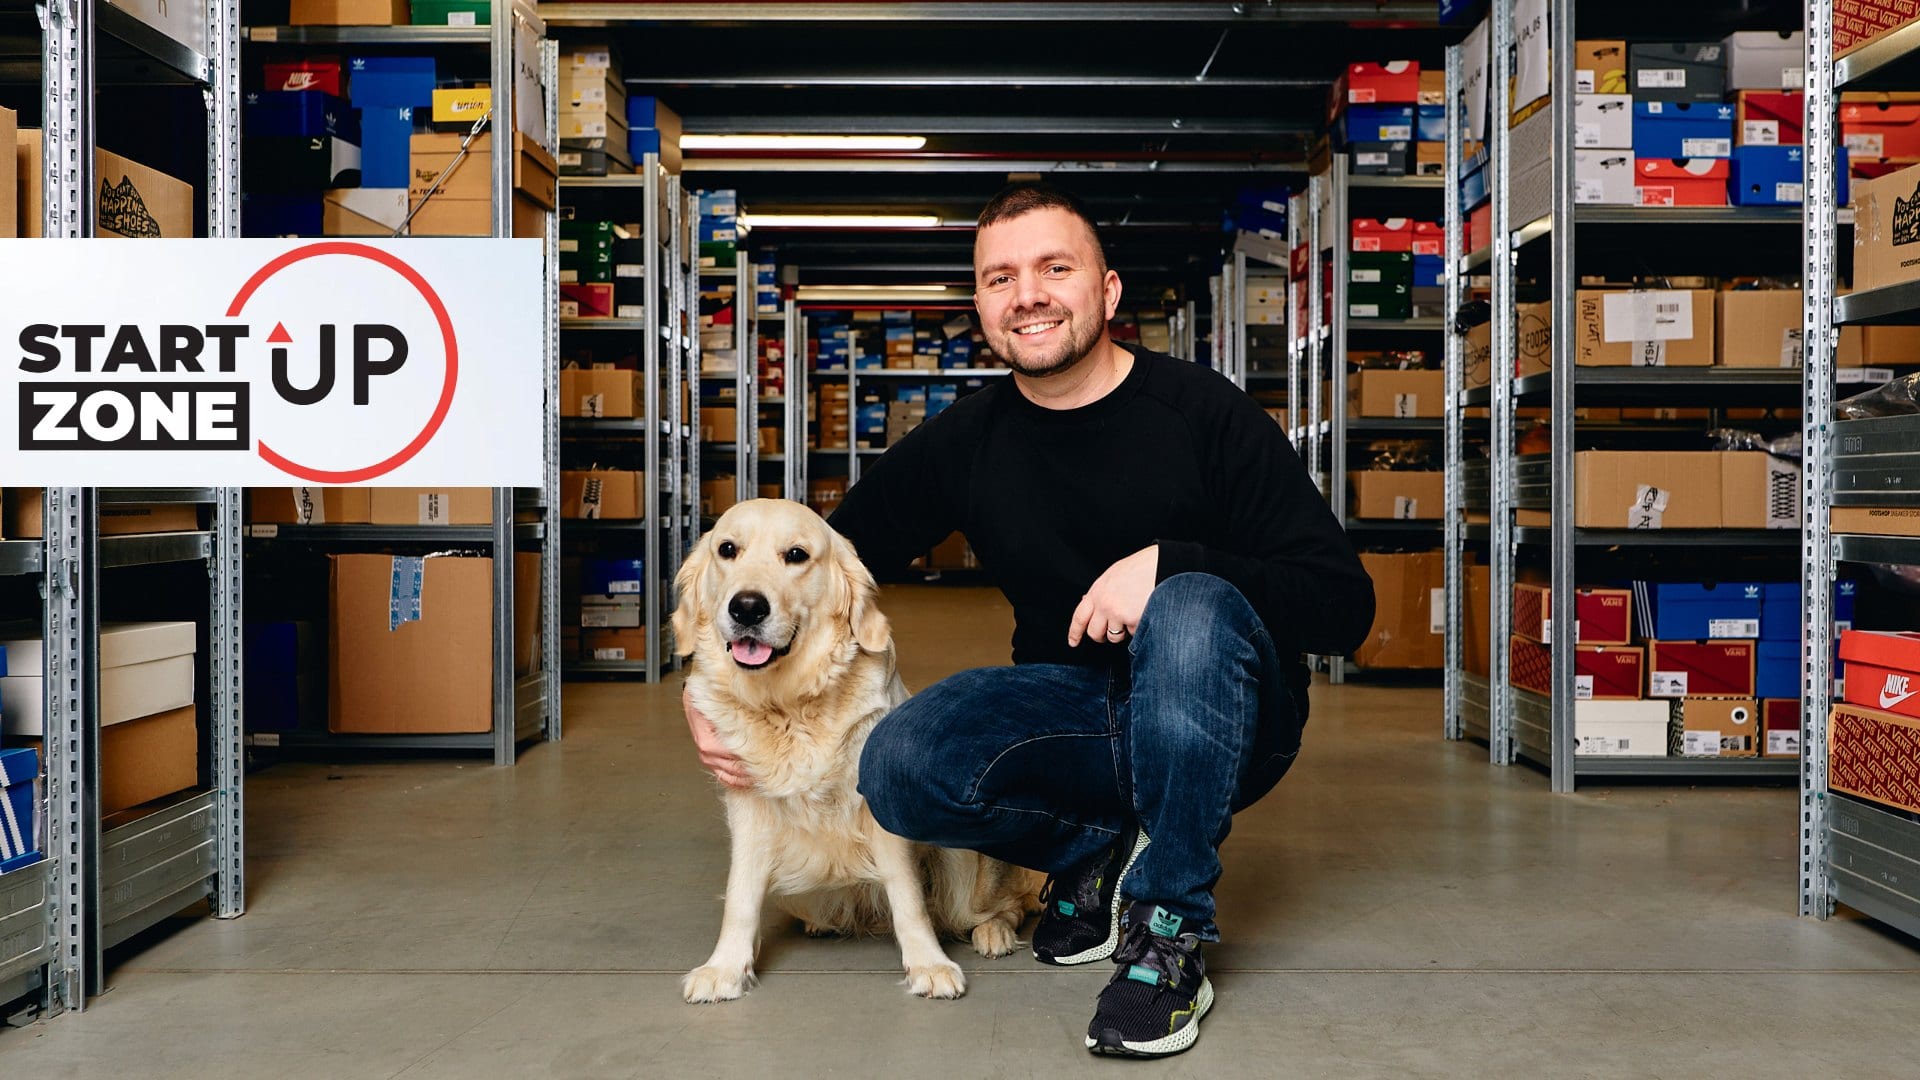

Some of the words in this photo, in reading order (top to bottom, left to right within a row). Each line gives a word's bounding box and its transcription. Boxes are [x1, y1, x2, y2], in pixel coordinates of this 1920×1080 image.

[1847, 16, 1865, 33] VANS
[1860, 3, 1880, 21] VANS
[1880, 9, 1900, 27] VANS
[288, 72, 313, 85] NIKE
[456, 98, 485, 111] union
[115, 212, 150, 232] SHOES
[1601, 597, 1623, 607] VANS
[1615, 655, 1637, 665] VANS
[1724, 647, 1747, 657] VANS
[1885, 674, 1911, 697] NIKE
[1844, 713, 1862, 739] VANS
[1848, 735, 1867, 761] VANS
[1862, 732, 1882, 760] VANS
[1877, 729, 1897, 757] VANS
[1892, 726, 1914, 755] VANS
[1834, 737, 1853, 764] VANS
[1853, 757, 1872, 785] VANS
[1868, 755, 1887, 783] VANS
[1882, 752, 1903, 780] VANS
[1897, 750, 1918, 778] VANS
[1840, 763, 1858, 787] VANS
[1887, 776, 1908, 805] VANS
